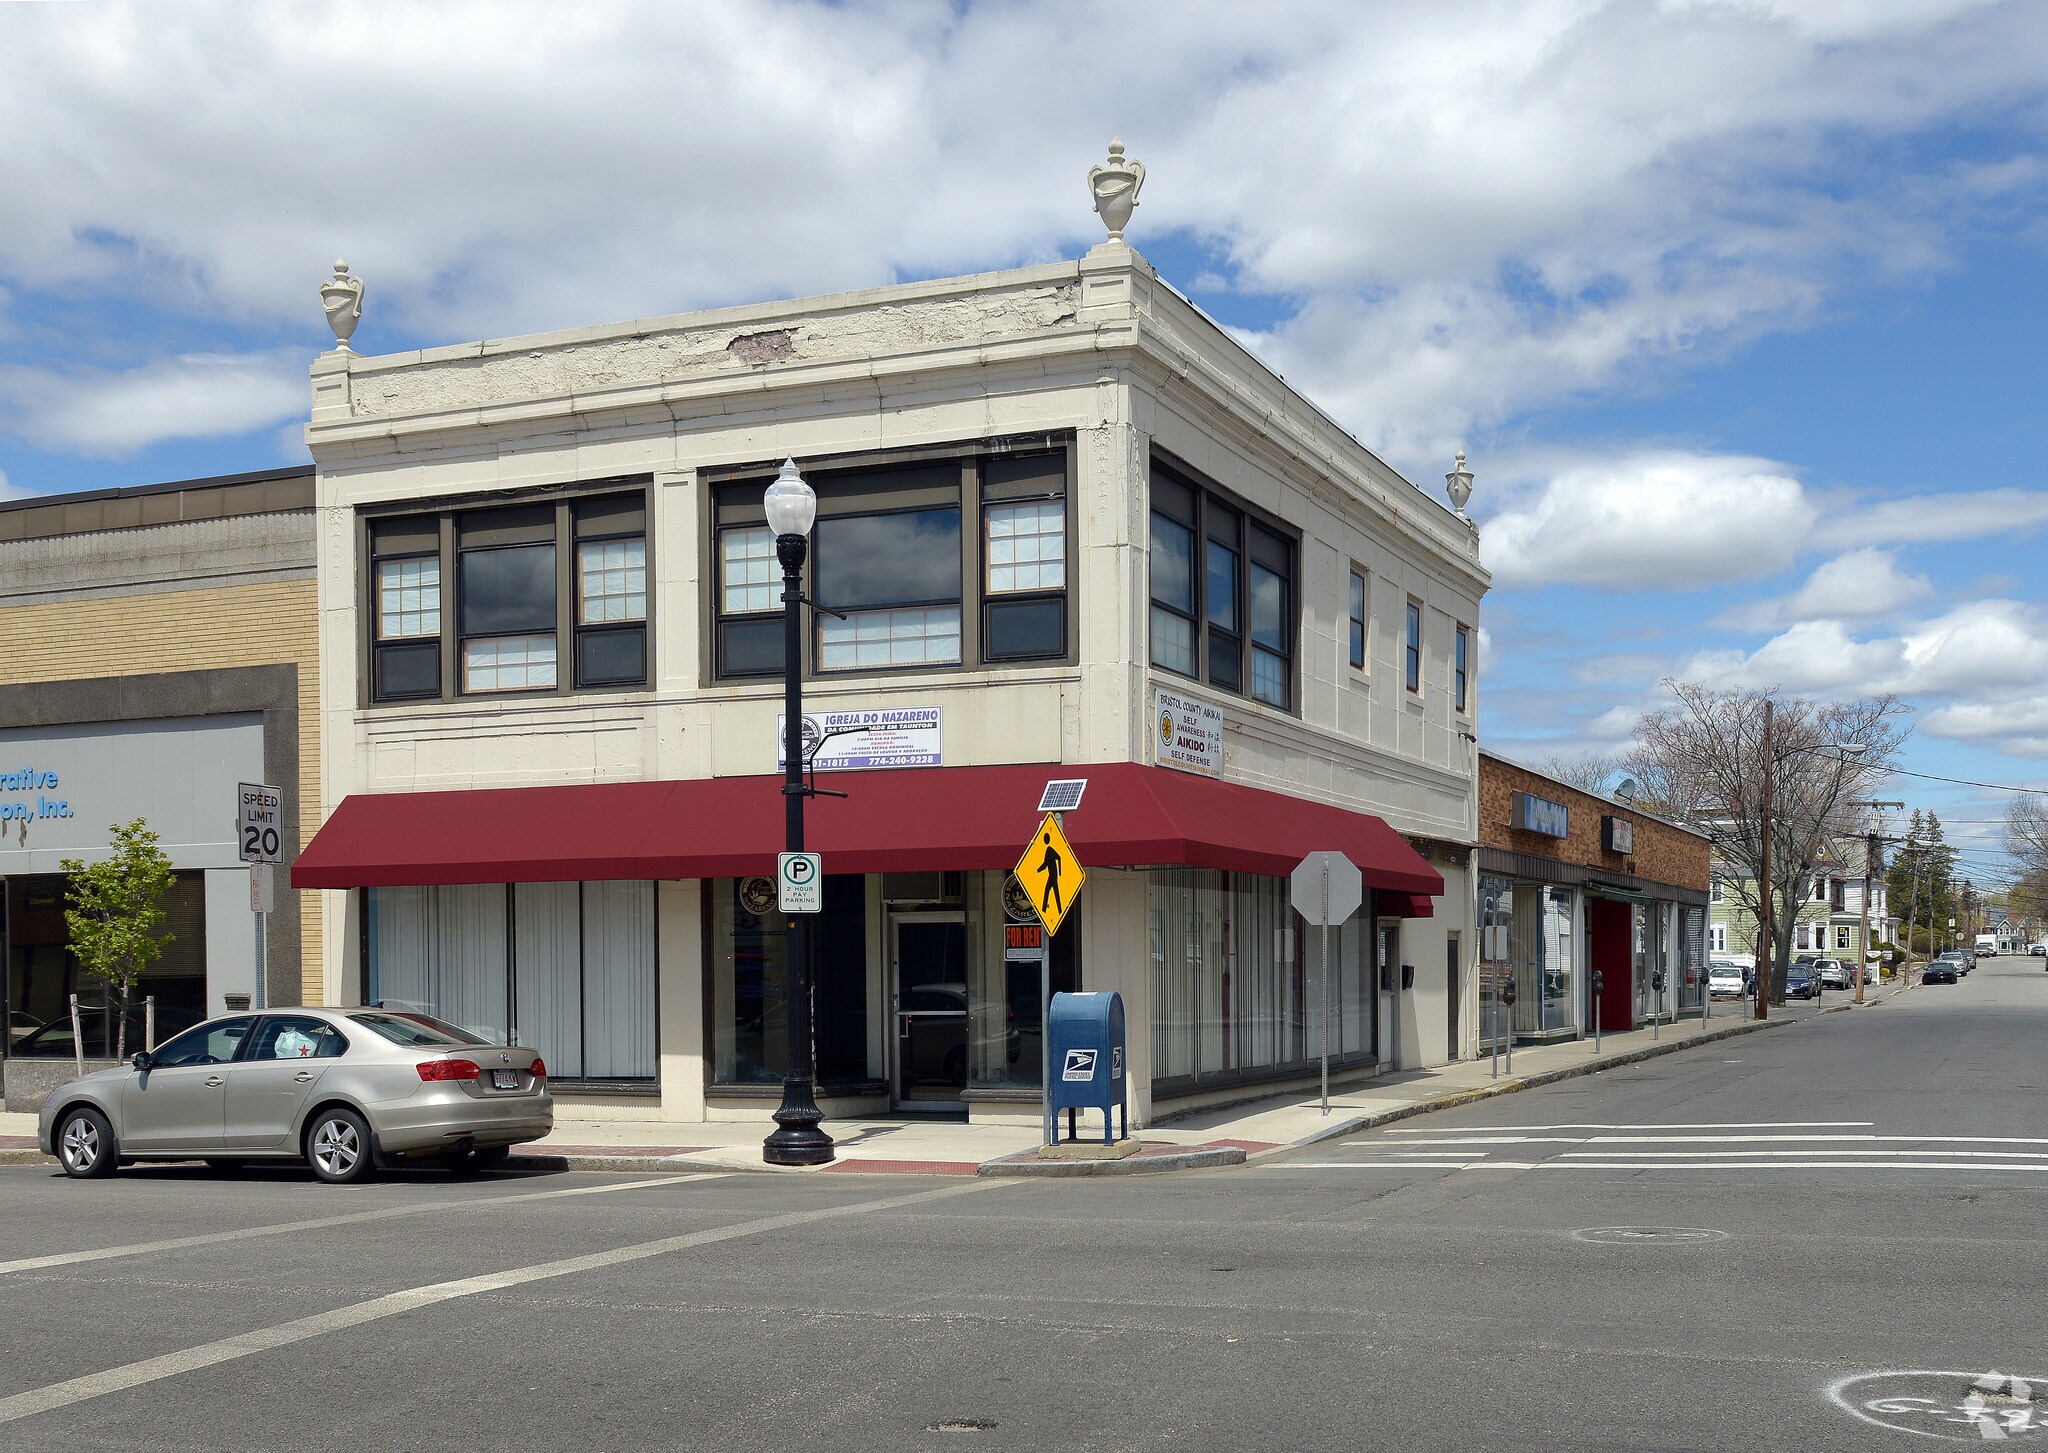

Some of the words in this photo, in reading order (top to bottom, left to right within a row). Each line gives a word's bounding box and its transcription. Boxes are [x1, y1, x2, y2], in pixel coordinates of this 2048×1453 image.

[1160, 694, 1182, 709] BRISTOL
[1182, 702, 1202, 715] COUNTY
[825, 714, 860, 725] IGREJA
[863, 713, 878, 724] DO
[881, 710, 938, 723] NAZARENO
[1183, 715, 1198, 726] SELF
[899, 722, 933, 730] TAUNTON
[1176, 723, 1206, 738] AWARENESS
[1177, 735, 1205, 752] AIKIDO
[868, 755, 934, 766] 774-240-9228
[1170, 749, 1185, 760] SELF
[1186, 753, 1211, 766] DEFENSE
[38, 795, 74, 819] Inc.
[243, 793, 278, 807] SPEED
[248, 810, 274, 823] LIMIT
[244, 825, 279, 856] 20
[792, 861, 808, 879] P
[1006, 926, 1022, 947] FOR
[1023, 926, 1042, 947] RENT
